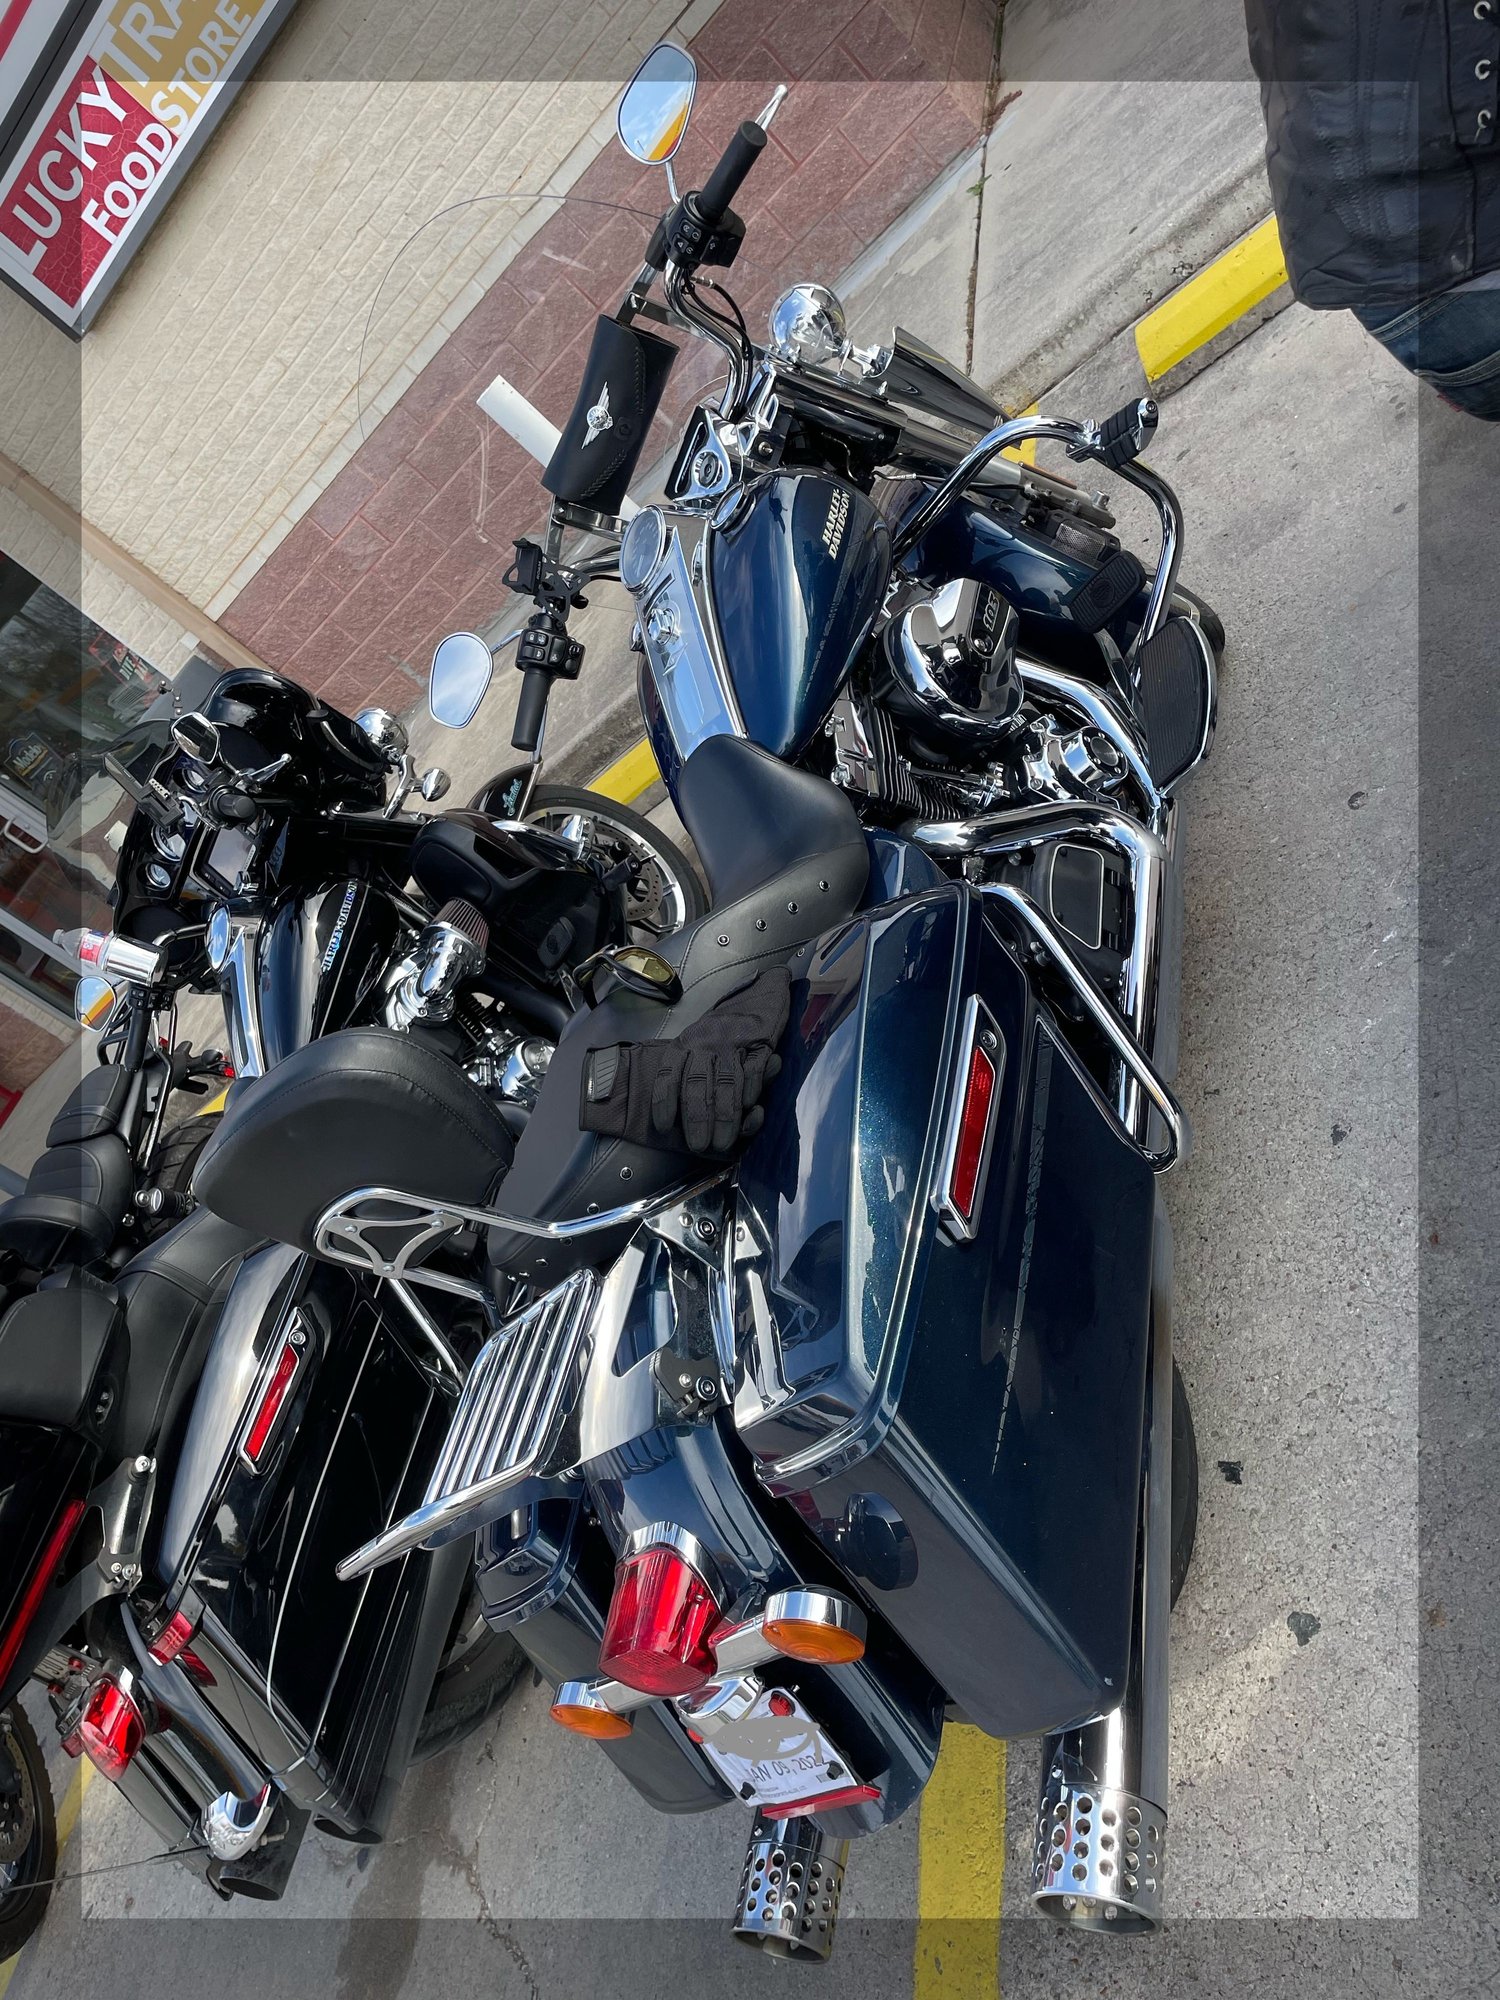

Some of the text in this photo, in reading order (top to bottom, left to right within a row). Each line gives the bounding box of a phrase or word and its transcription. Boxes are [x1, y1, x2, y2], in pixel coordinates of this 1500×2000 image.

[80, 3, 252, 246] FOOD STORE
[0, 66, 128, 276] LUCKY
[822, 488, 841, 546] HARLEY-
[828, 490, 850, 560] DAVIDSON
[13, 744, 44, 769] Modelo
